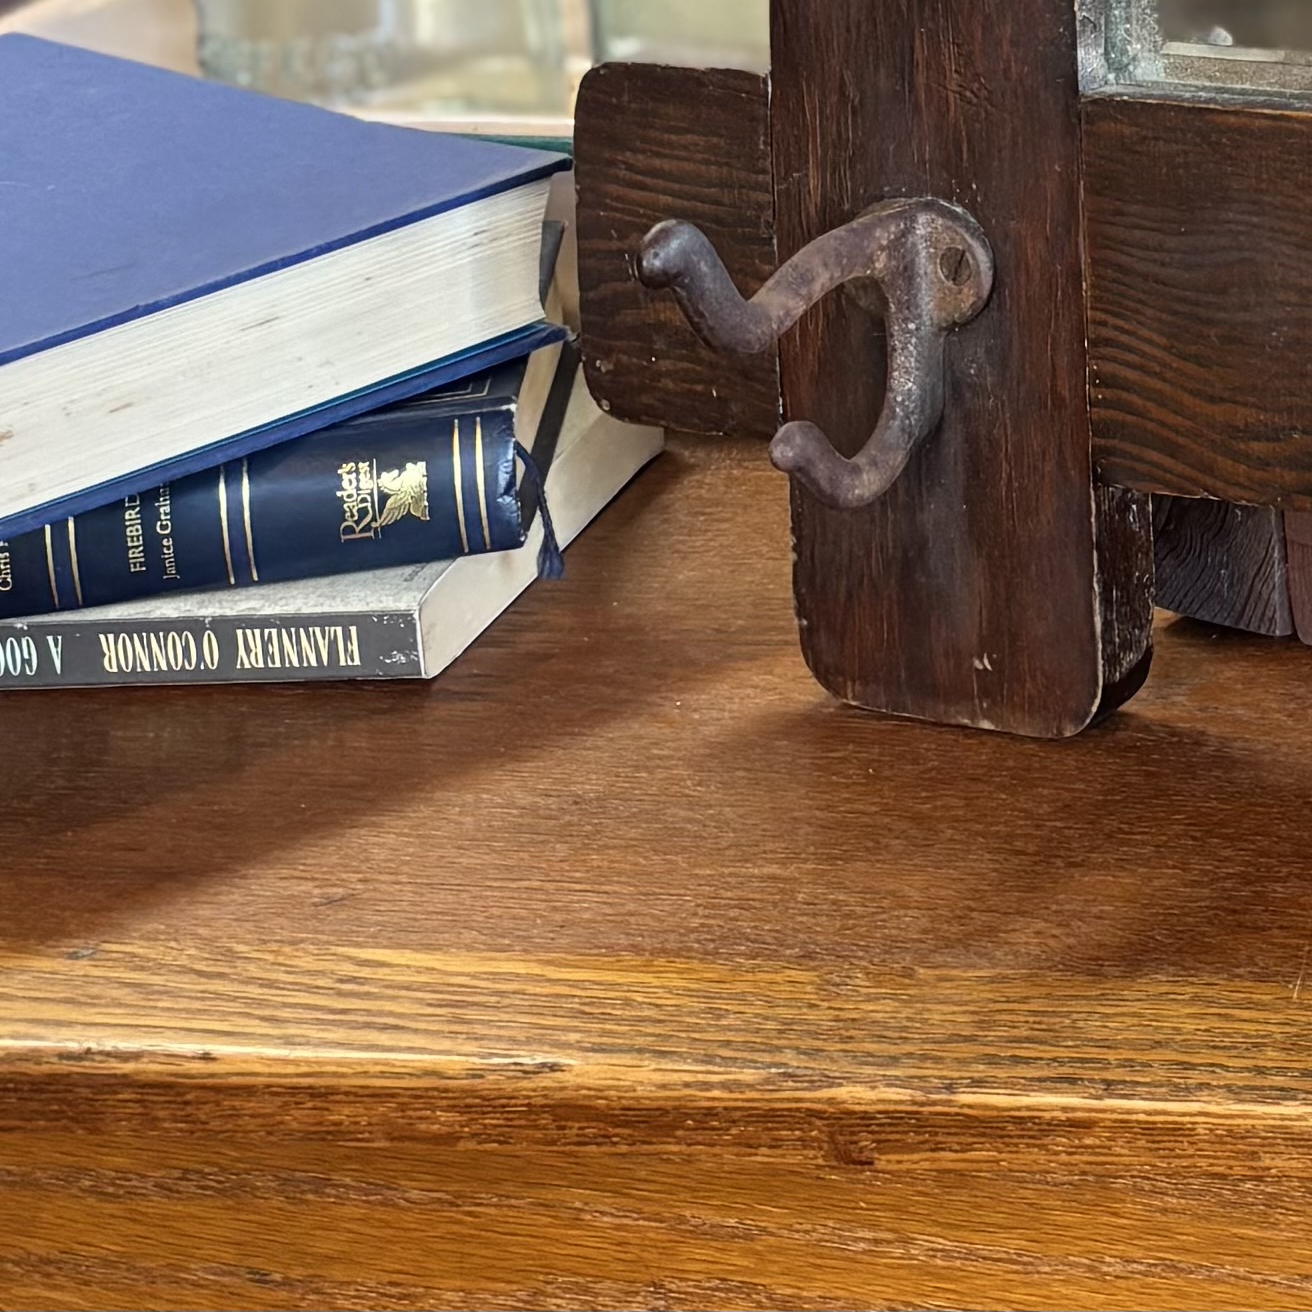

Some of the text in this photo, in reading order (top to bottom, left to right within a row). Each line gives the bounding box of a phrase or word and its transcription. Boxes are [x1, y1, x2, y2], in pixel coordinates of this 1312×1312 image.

[336, 462, 375, 543] Reader's
[125, 492, 147, 573] FIREBIRD
[162, 538, 181, 579] Janice
[46, 635, 63, 675] A
[99, 629, 219, 673] O'CONNOR
[235, 626, 361, 669] FLANNERY
